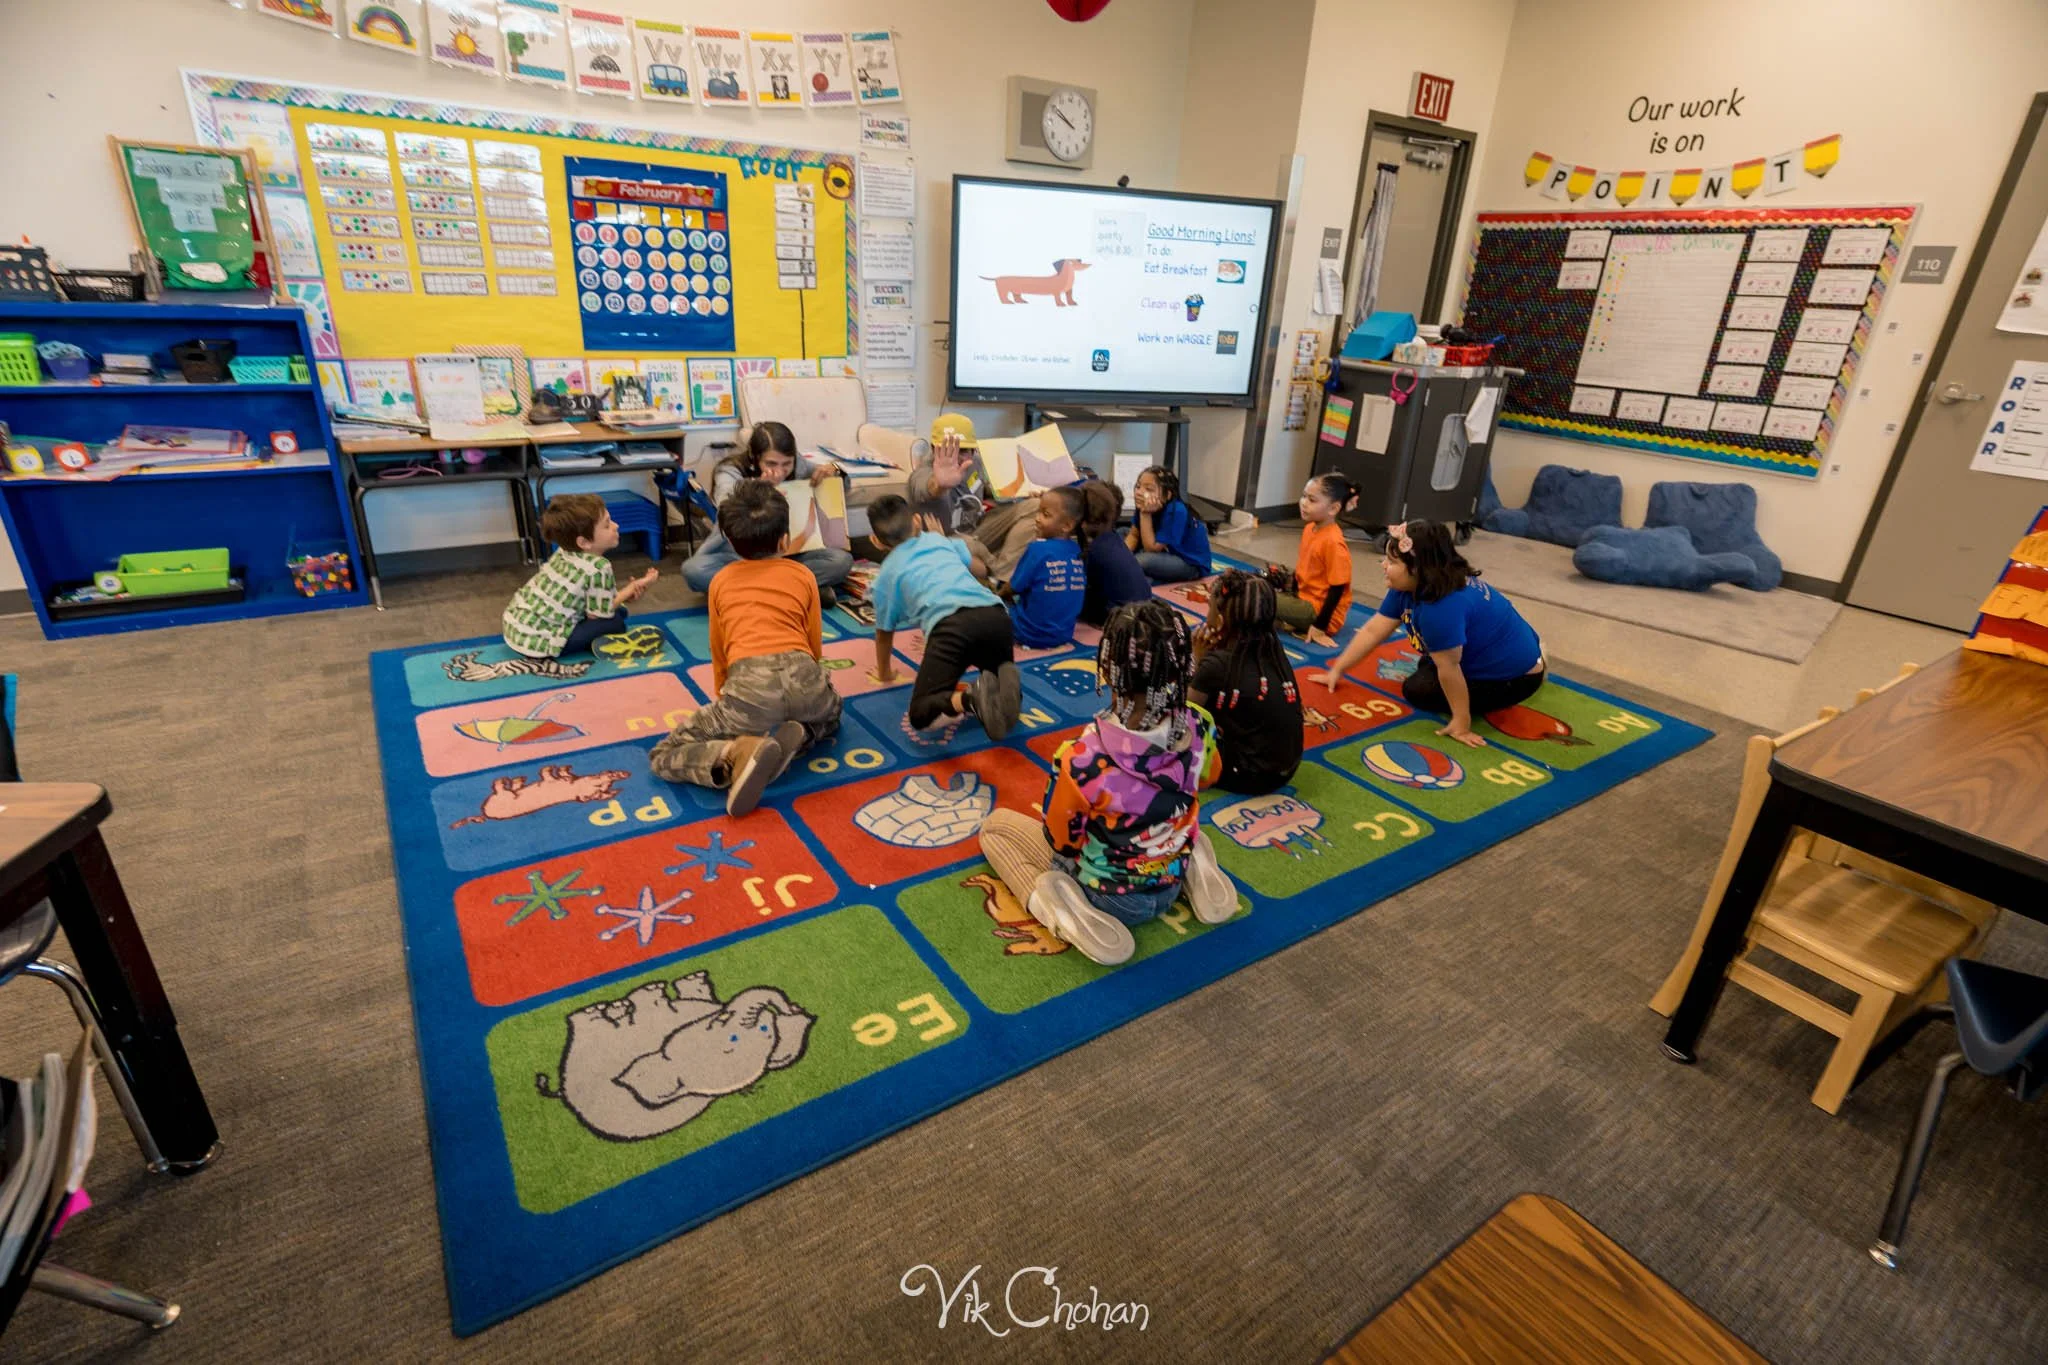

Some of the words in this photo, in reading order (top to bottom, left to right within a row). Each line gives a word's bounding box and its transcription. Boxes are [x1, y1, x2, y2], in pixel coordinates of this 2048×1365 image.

[643, 35, 682, 64] Vv
[697, 43, 742, 69] Ww
[760, 47, 794, 73] Xx
[812, 47, 843, 77] Yy
[863, 45, 889, 69] Zz
[1418, 78, 1450, 117] EXIT
[1628, 97, 1674, 123] Our
[1680, 88, 1746, 118] work
[1649, 132, 1668, 154] is
[1675, 133, 1705, 152] on
[619, 184, 683, 202] February
[1148, 223, 1175, 238] Good
[1177, 225, 1223, 246] Morning
[1225, 229, 1257, 243] Lions!
[1324, 239, 1340, 248] EXIT
[1147, 244, 1158, 255] To
[1144, 262, 1160, 273] Eat
[1162, 263, 1209, 276] Breakfast
[1917, 259, 1941, 271] 110
[1141, 297, 1167, 310] Clean
[1169, 301, 1181, 312] up
[1137, 332, 1160, 344] Work
[1163, 334, 1174, 344] on
[1176, 333, 1213, 346] WAGGLE
[648, 371, 678, 383] TURNS
[1338, 700, 1406, 721] Gg
[1598, 711, 1650, 736] Aa
[807, 748, 884, 774] Oo
[1481, 759, 1547, 787] Bb
[588, 795, 672, 827] Pp
[1352, 811, 1421, 841] Cc
[741, 873, 814, 916] Jj
[851, 992, 959, 1046] Ee
